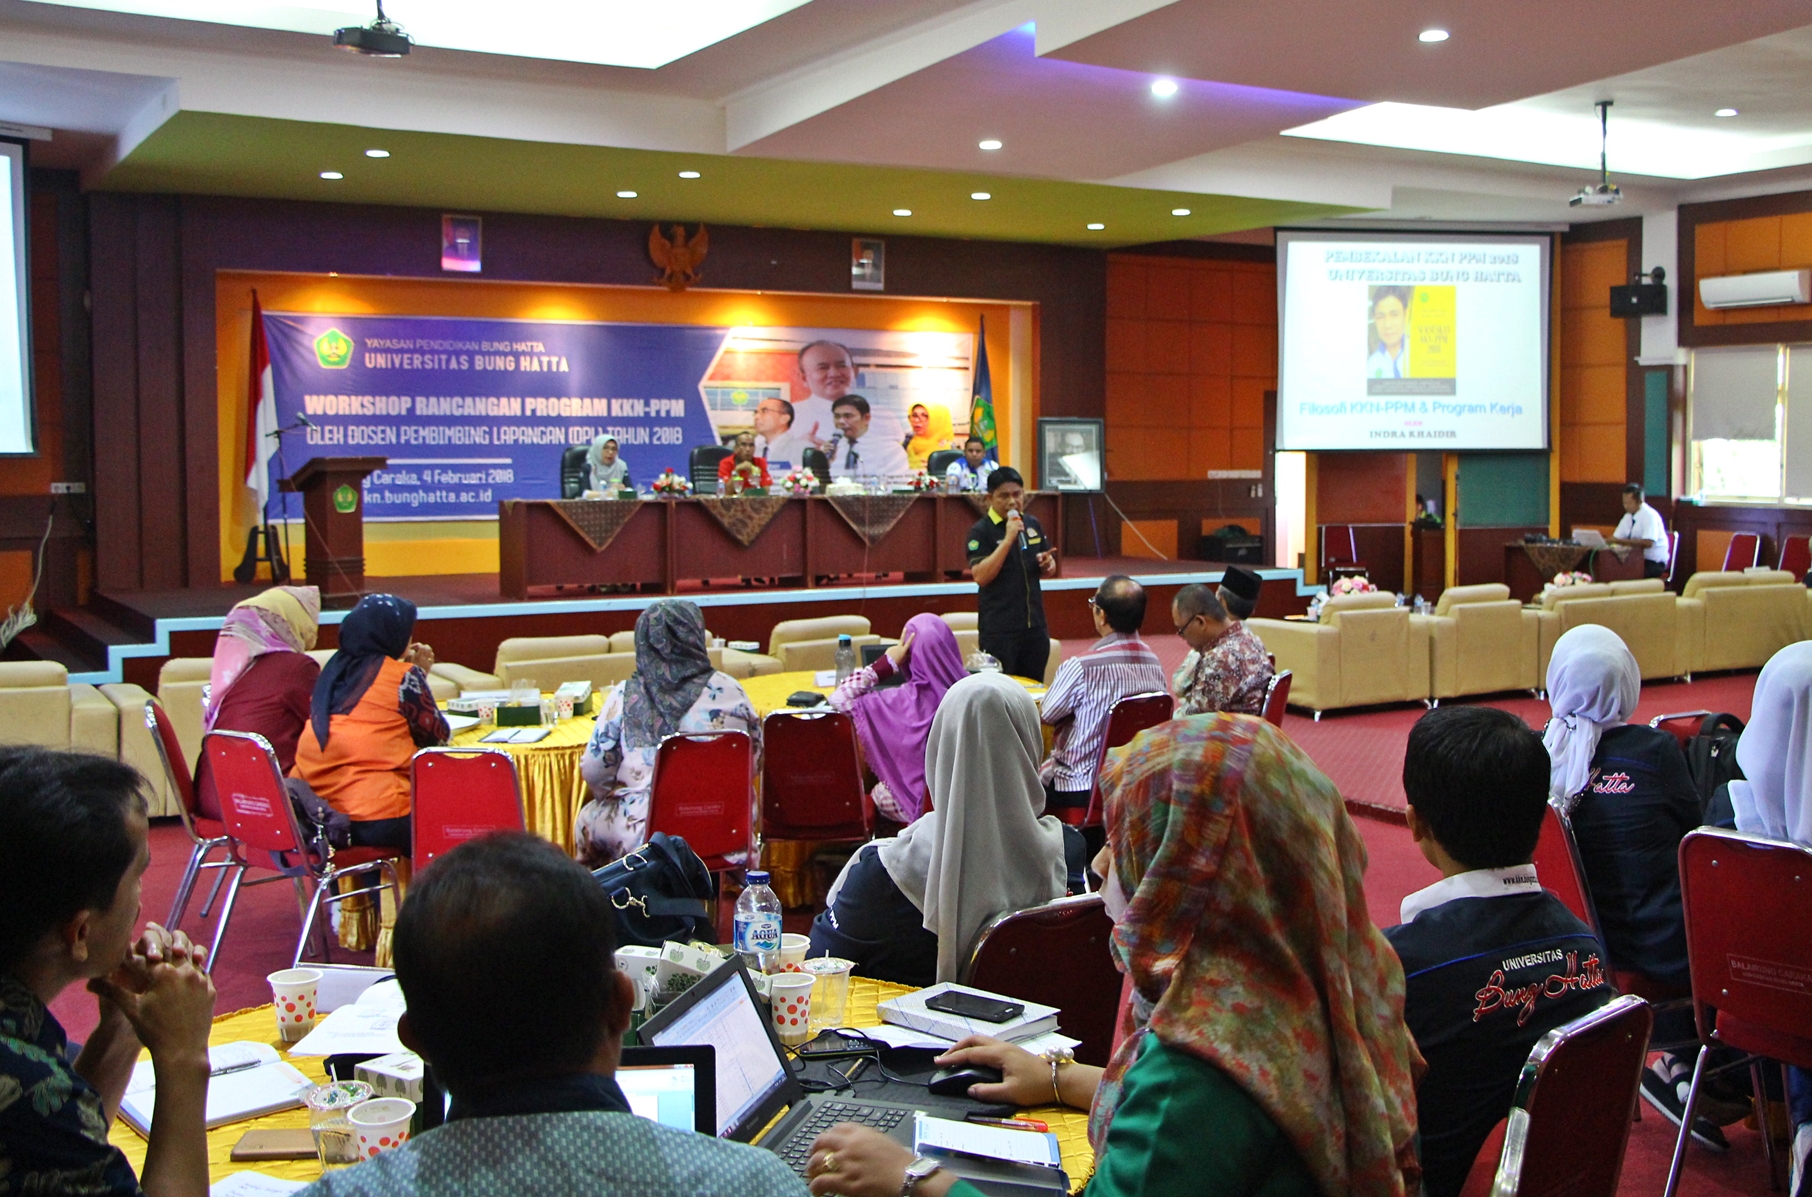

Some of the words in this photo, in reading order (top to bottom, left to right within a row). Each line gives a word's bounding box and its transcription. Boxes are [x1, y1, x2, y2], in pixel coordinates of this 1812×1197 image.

[1324, 249, 1420, 264] PEMBEKALAN
[1424, 251, 1455, 265] KKN
[1458, 252, 1486, 265] PPM
[1327, 268, 1426, 282] UNIVERSITAS
[1429, 270, 1470, 283] BUNG
[1473, 270, 1522, 283] HATTA
[365, 338, 413, 349] YAYASAN
[416, 339, 479, 351] PENDIDIKAN
[482, 341, 511, 352] BUNG
[512, 341, 546, 353] HATTA
[364, 352, 469, 370] UNIVERSITAS
[475, 355, 516, 371] BUNG
[520, 355, 570, 372] HATTA
[304, 395, 412, 416] WORKSHOP
[415, 396, 521, 417] RANCANGAN
[525, 397, 608, 417] PROGRAM
[611, 398, 685, 418] KKN-PPM
[1299, 401, 1347, 415] Filosofi
[1350, 401, 1416, 415] KKN-PPM
[1419, 401, 1429, 414] &
[1432, 401, 1487, 417] Program
[1490, 401, 1523, 418] Kerja
[306, 425, 345, 445] OLEH
[347, 426, 396, 445] DOSEN
[400, 426, 490, 445] PEMBIMBING
[493, 426, 565, 445] LAPANGAN
[606, 427, 649, 445] TAHUN
[653, 427, 683, 445] 2018
[1369, 430, 1406, 439] INDRA
[1409, 430, 1457, 439] KHAIDIR
[423, 470, 432, 484] 4
[434, 470, 486, 484] Februari
[488, 469, 515, 484] 2018
[750, 928, 779, 941] AQUA
[1502, 949, 1564, 972] UNIVERSITAS
[1472, 969, 1544, 1028] Bung
